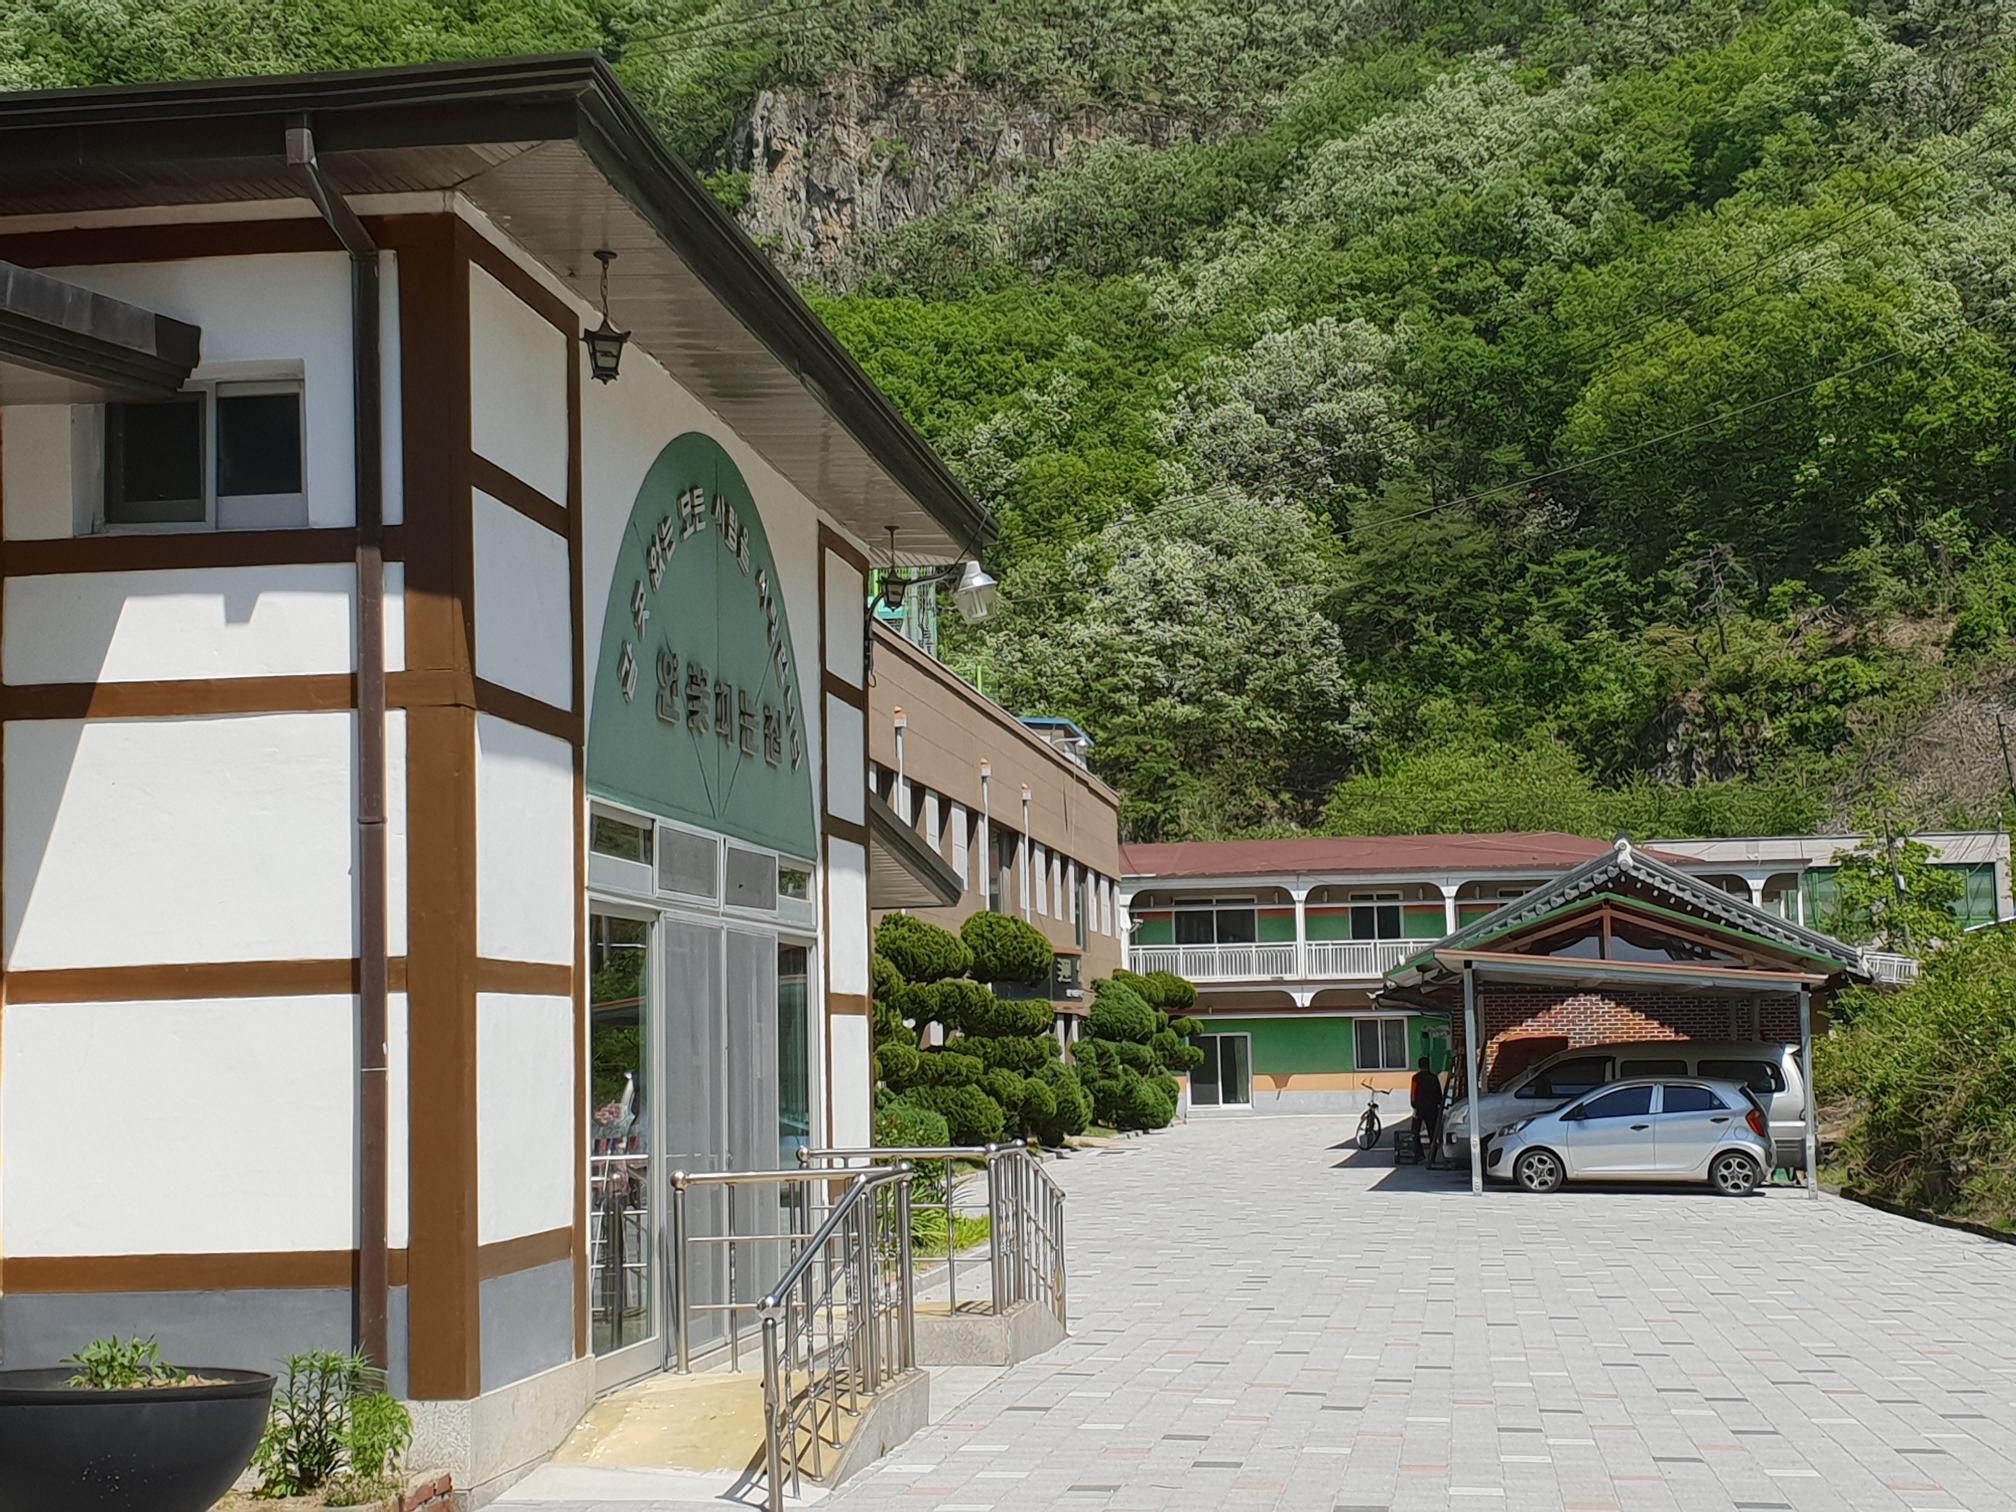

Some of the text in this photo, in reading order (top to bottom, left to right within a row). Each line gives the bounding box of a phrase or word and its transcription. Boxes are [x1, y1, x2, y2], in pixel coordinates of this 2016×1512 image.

[679, 487, 707, 543] 모든
[713, 495, 750, 576] 사람을
[756, 568, 801, 772] 사랑합니다
